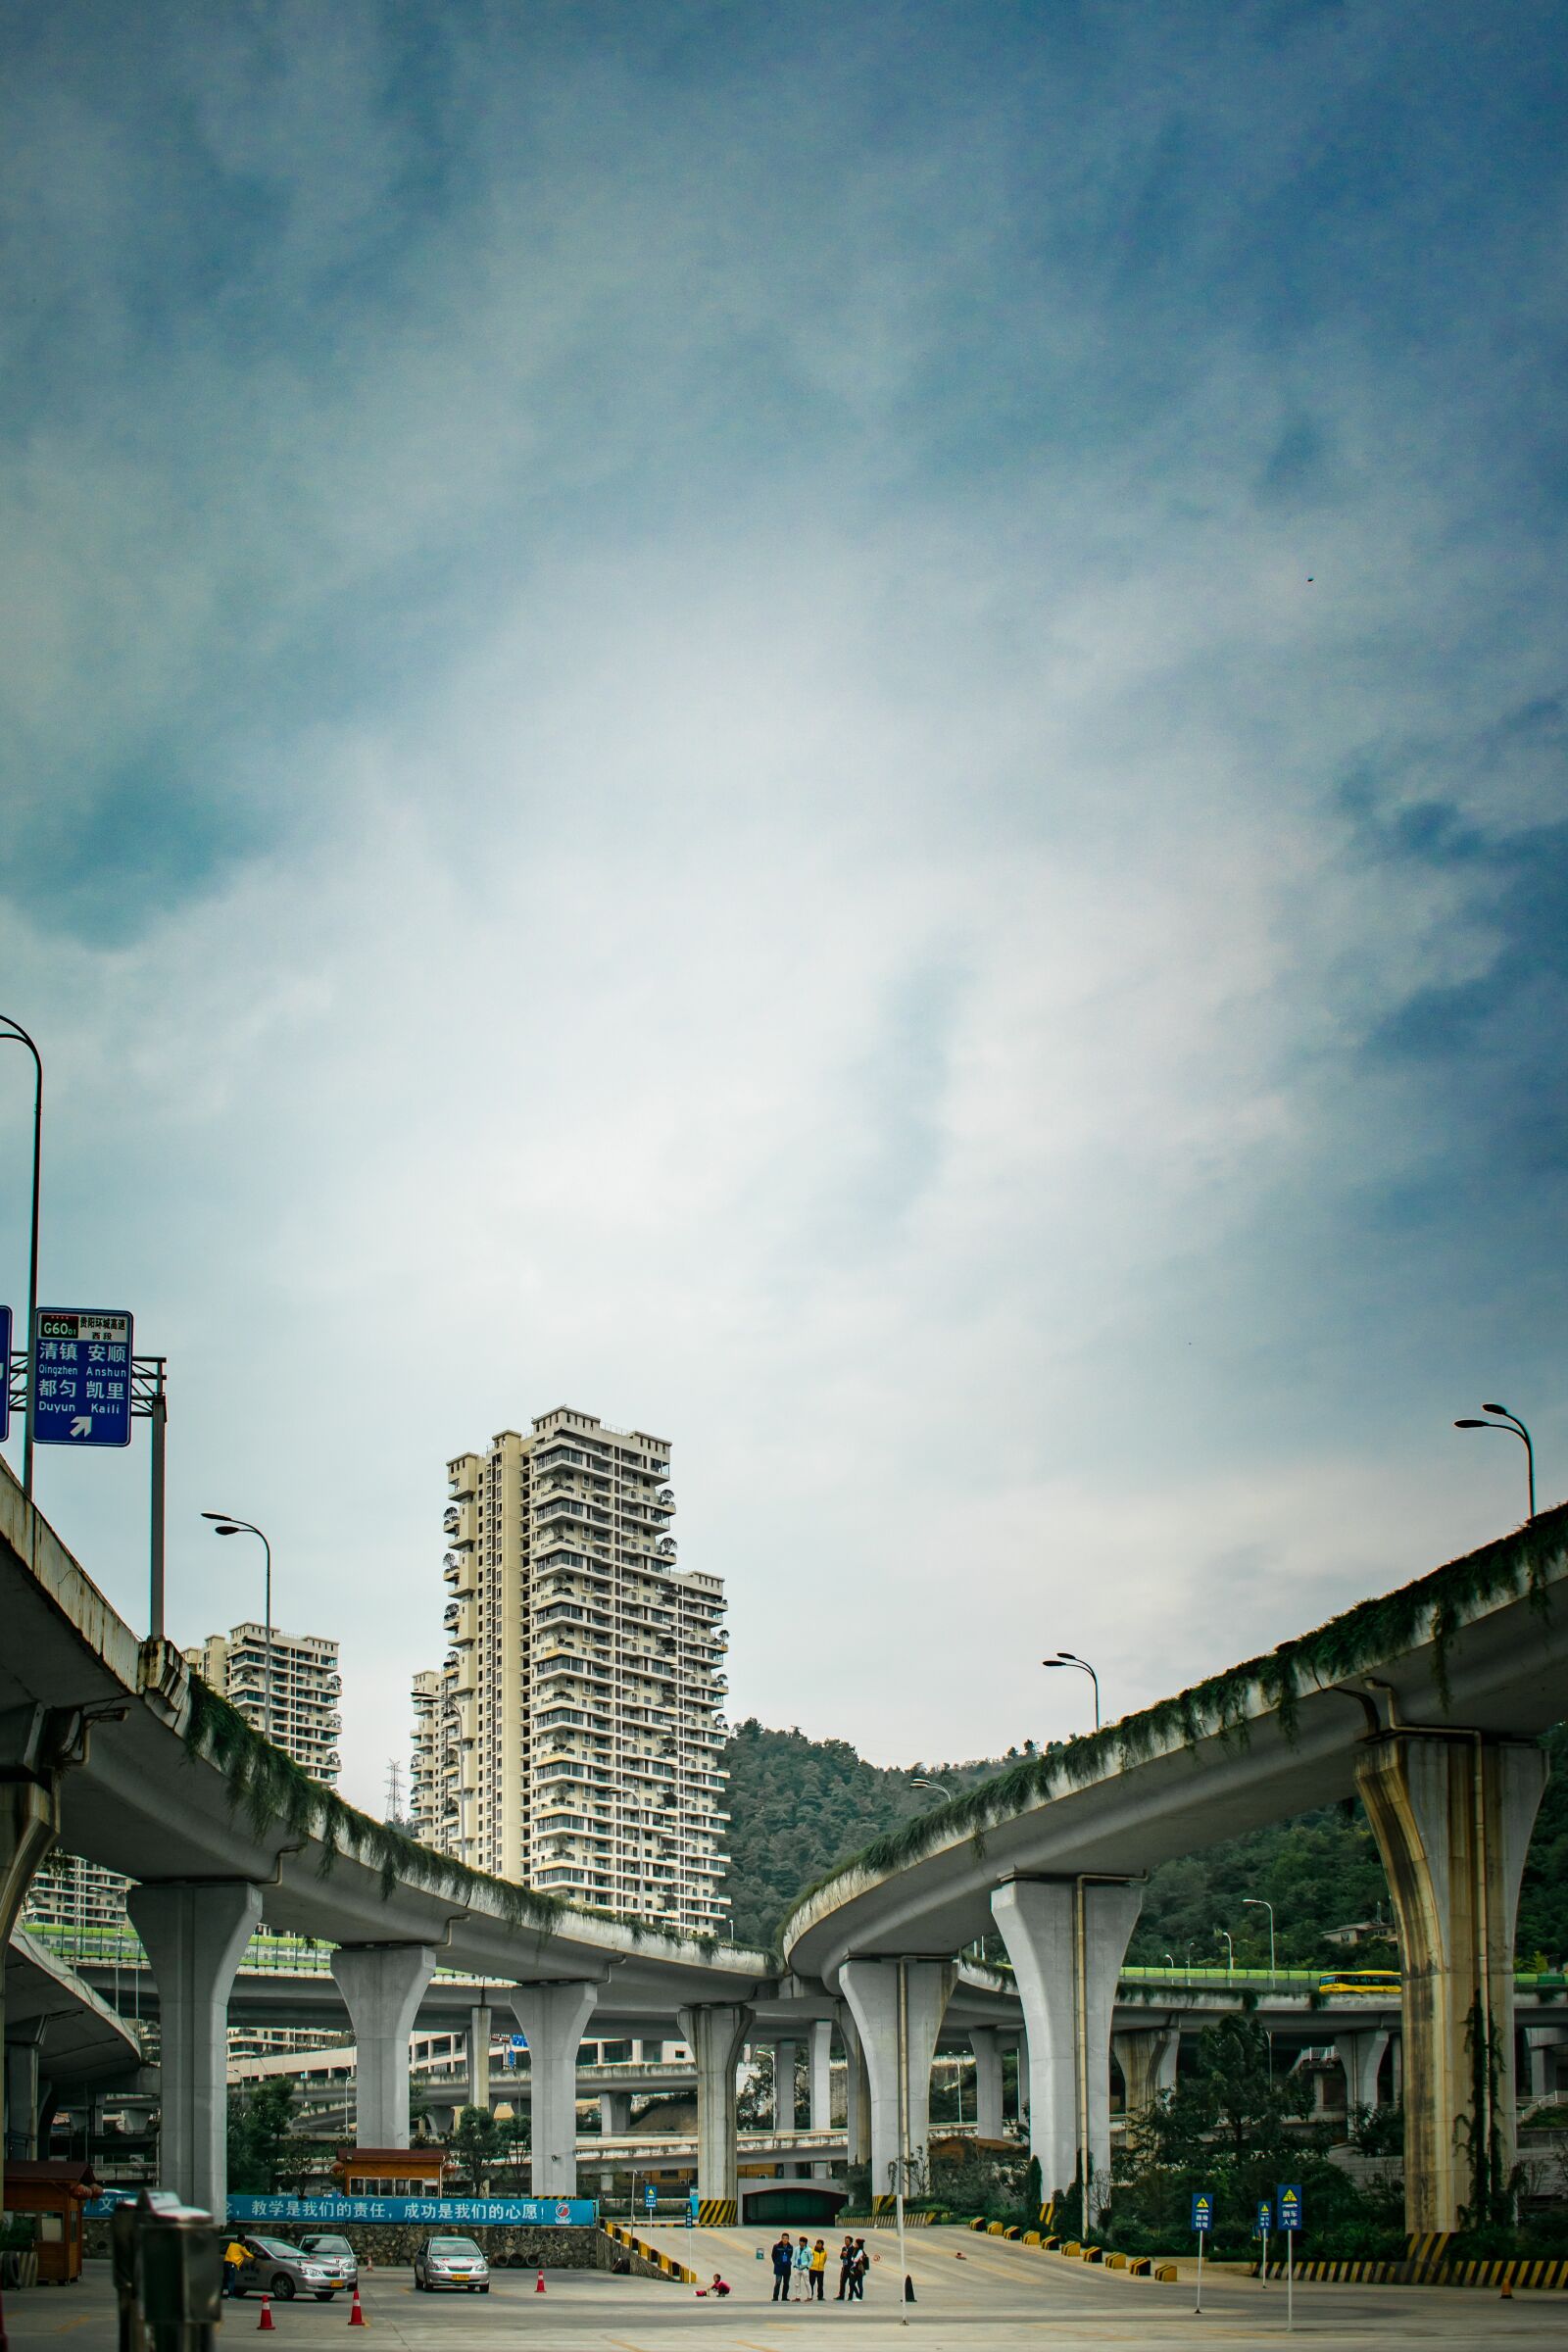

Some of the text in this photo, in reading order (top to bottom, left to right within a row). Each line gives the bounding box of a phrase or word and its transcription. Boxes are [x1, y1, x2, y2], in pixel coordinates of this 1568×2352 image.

[39, 1342, 126, 1363] 清镇 安顺
[39, 1364, 126, 1377] Qingzhen Anshun
[39, 1378, 124, 1399] 都匀 凯里
[39, 1401, 120, 1414] Duyun Kaili
